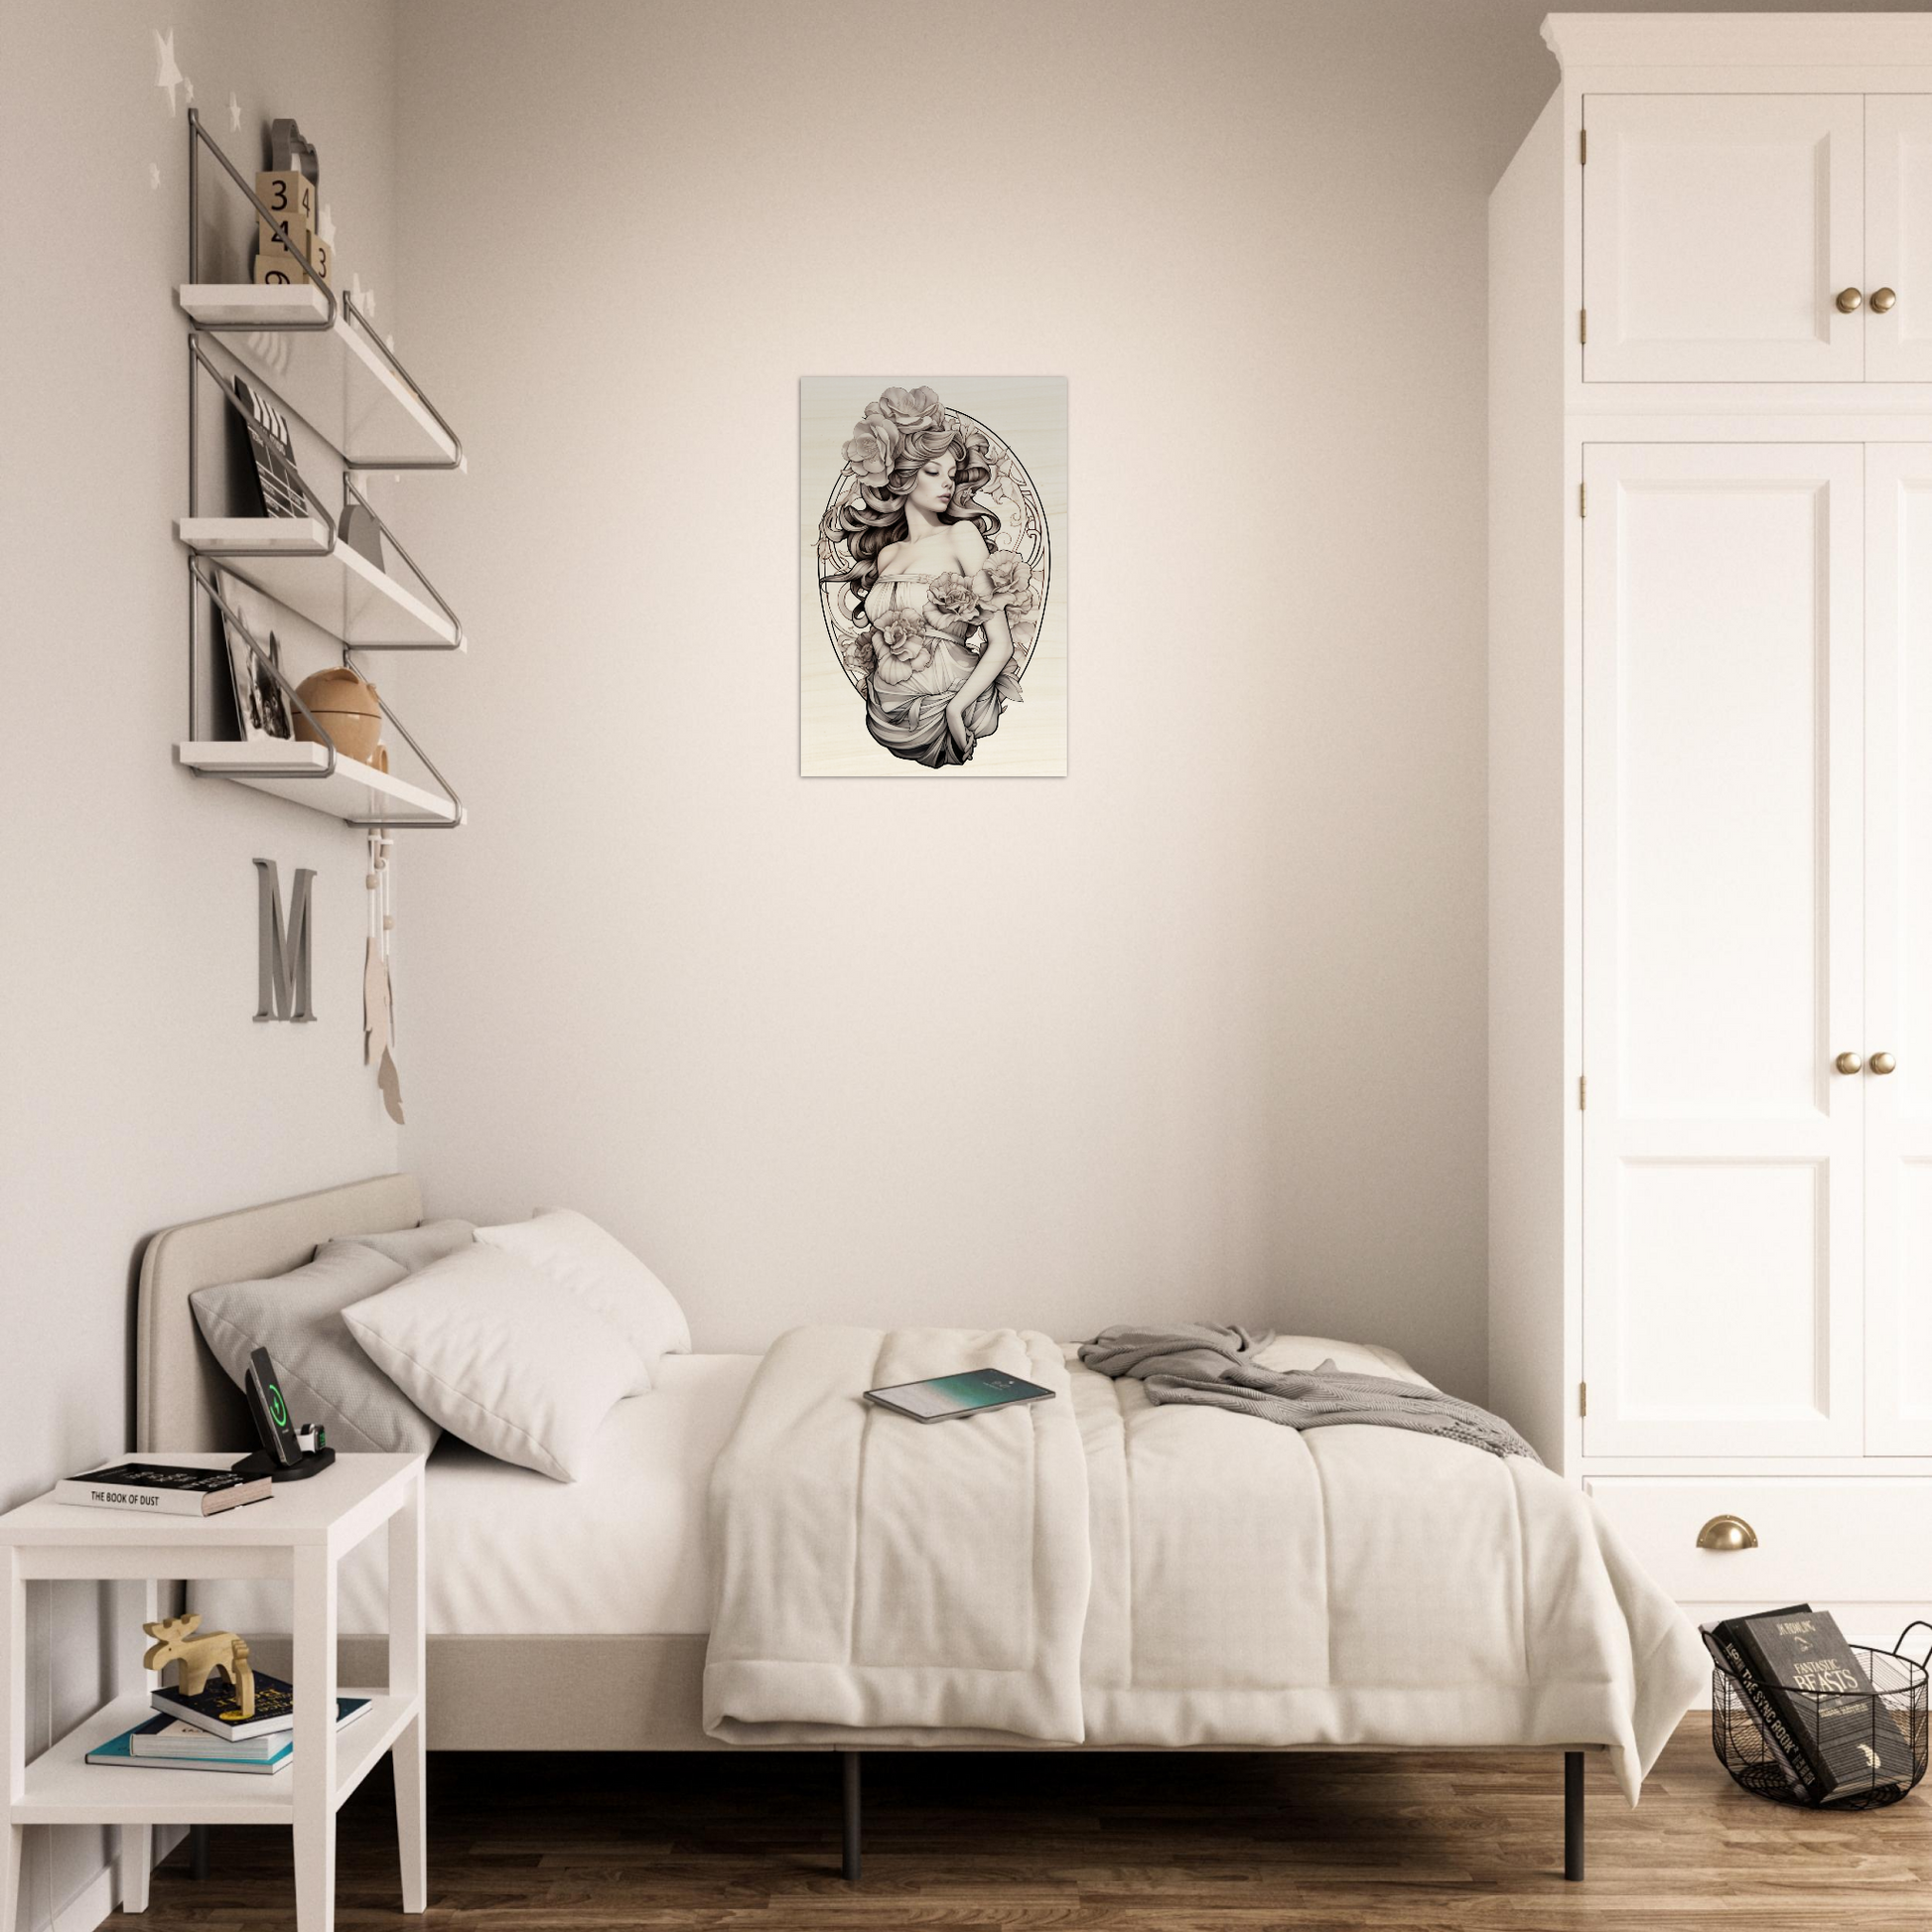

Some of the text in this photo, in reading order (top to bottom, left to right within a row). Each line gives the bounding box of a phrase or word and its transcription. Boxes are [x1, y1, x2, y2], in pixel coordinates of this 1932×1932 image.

[271, 180, 288, 211] 3
[302, 188, 311, 218] 4
[270, 220, 290, 252] 4
[318, 247, 327, 278] 3
[252, 858, 318, 1024] M
[91, 1490, 160, 1507] THE BOOK OF DUST
[1793, 1658, 1842, 1675] FANTASTIC
[1792, 1669, 1859, 1695] BEASTS
